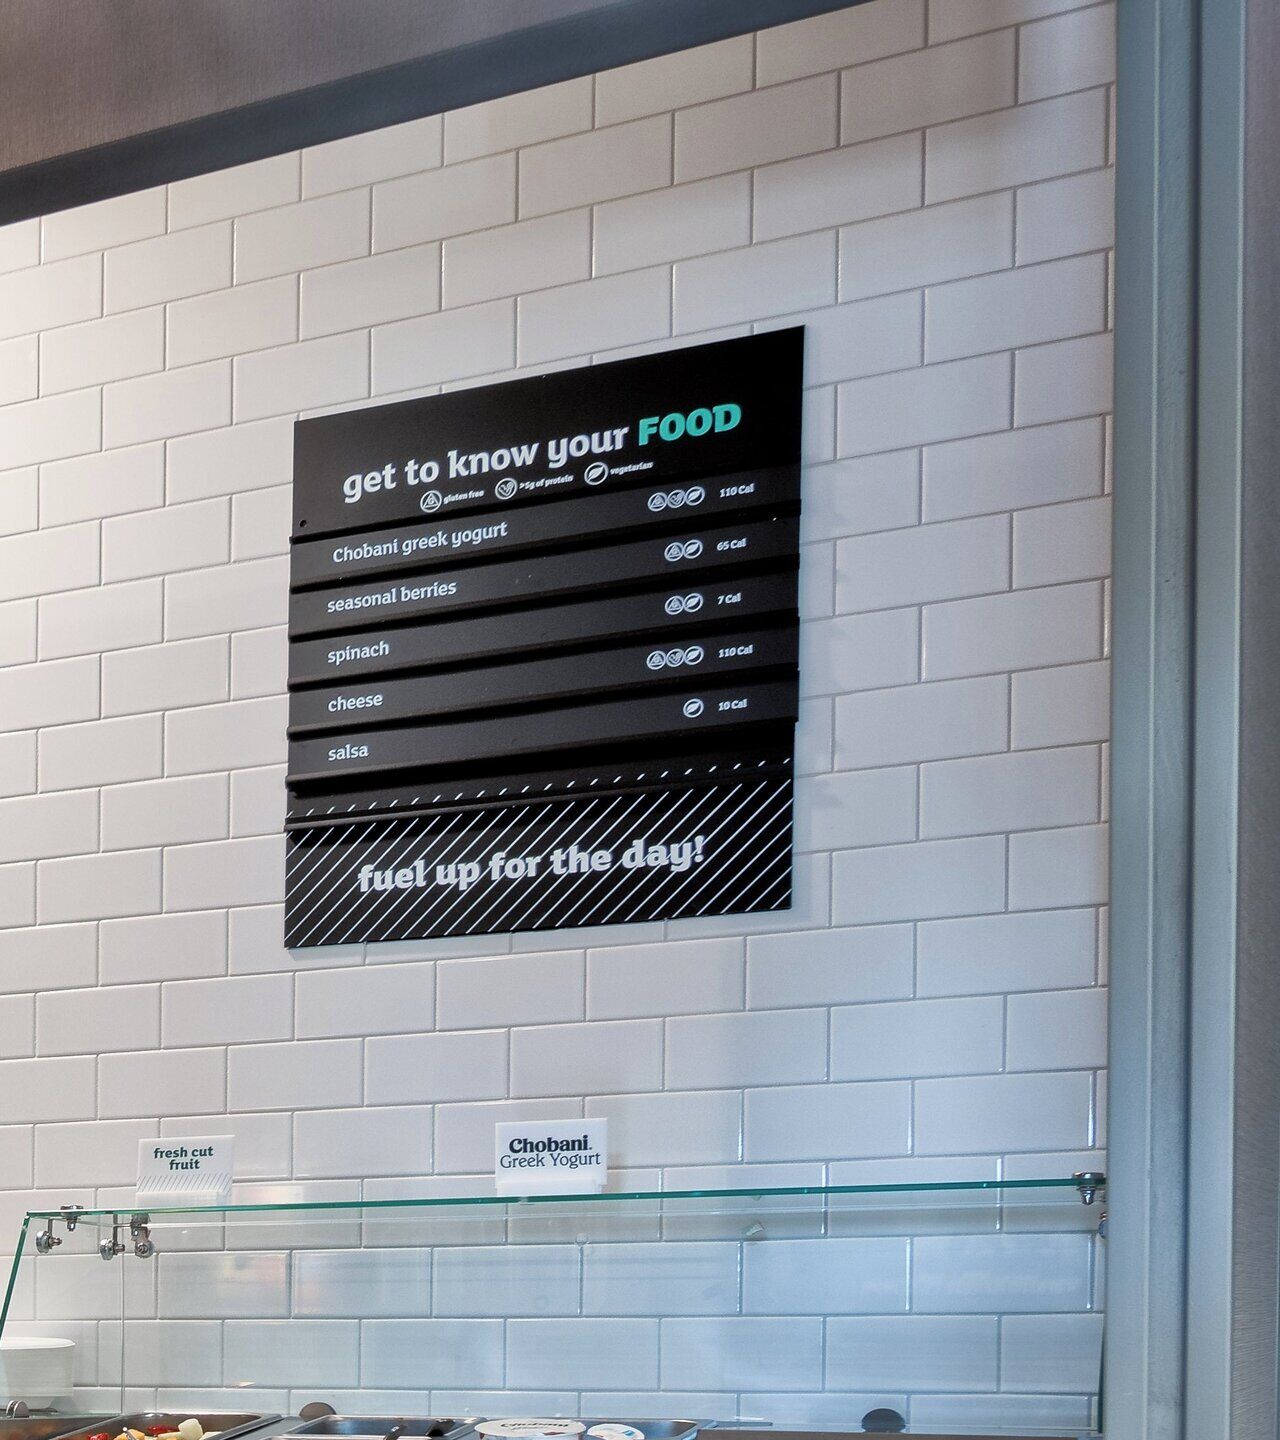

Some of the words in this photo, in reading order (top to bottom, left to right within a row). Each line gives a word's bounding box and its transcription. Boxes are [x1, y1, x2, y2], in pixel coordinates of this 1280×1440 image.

[342, 466, 397, 504] get
[405, 458, 440, 487] to
[447, 441, 540, 479] know
[547, 425, 629, 470] your
[638, 403, 742, 446] FOOD
[468, 489, 484, 499] free
[719, 486, 737, 498] 110
[738, 483, 755, 494] Cal
[332, 538, 399, 564] Chobani
[401, 530, 449, 557] greek
[451, 521, 508, 548] yogurt
[730, 538, 747, 549] Cal
[327, 587, 396, 614] seasonal
[400, 579, 457, 603] berries
[717, 596, 724, 605] 7
[725, 592, 742, 603] Cal
[327, 640, 390, 665] spinach
[718, 647, 737, 658] 110
[737, 644, 754, 656] Cal
[327, 692, 383, 712] cheese
[718, 701, 731, 711] 10
[731, 699, 748, 710] Cal
[327, 742, 369, 762] salsa
[358, 859, 425, 892] fuel
[436, 862, 481, 890] up
[489, 852, 543, 882] for
[549, 846, 612, 874] the
[622, 836, 706, 873] day!
[153, 1146, 188, 1160] fresh
[191, 1146, 214, 1158] cut
[500, 1153, 546, 1169] Greek
[549, 1152, 601, 1169] Yogurt
[169, 1158, 200, 1171] fruit
